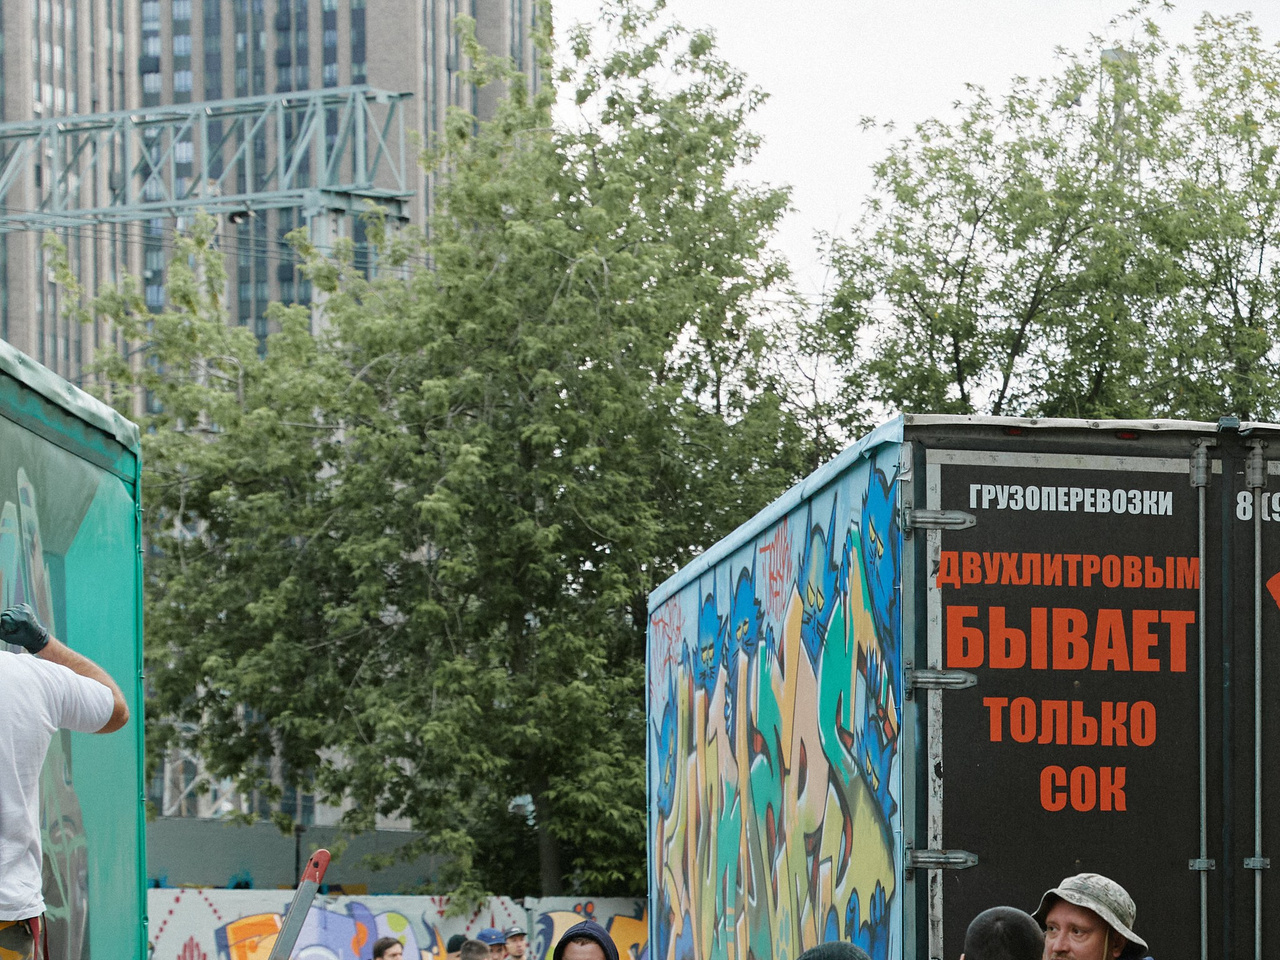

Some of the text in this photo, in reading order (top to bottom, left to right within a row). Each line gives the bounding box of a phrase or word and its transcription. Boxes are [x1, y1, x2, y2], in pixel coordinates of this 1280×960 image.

[969, 483, 1173, 516] ГРУЗОПЕРЕВОЗКИ
[1236, 490, 1253, 521] 8
[936, 550, 1200, 590] ДВУХЛИТРОВЫМ
[946, 604, 1196, 673] БЫВАЕТ
[983, 696, 1157, 747] ТОЛЬКО
[1040, 765, 1127, 812] СОК
